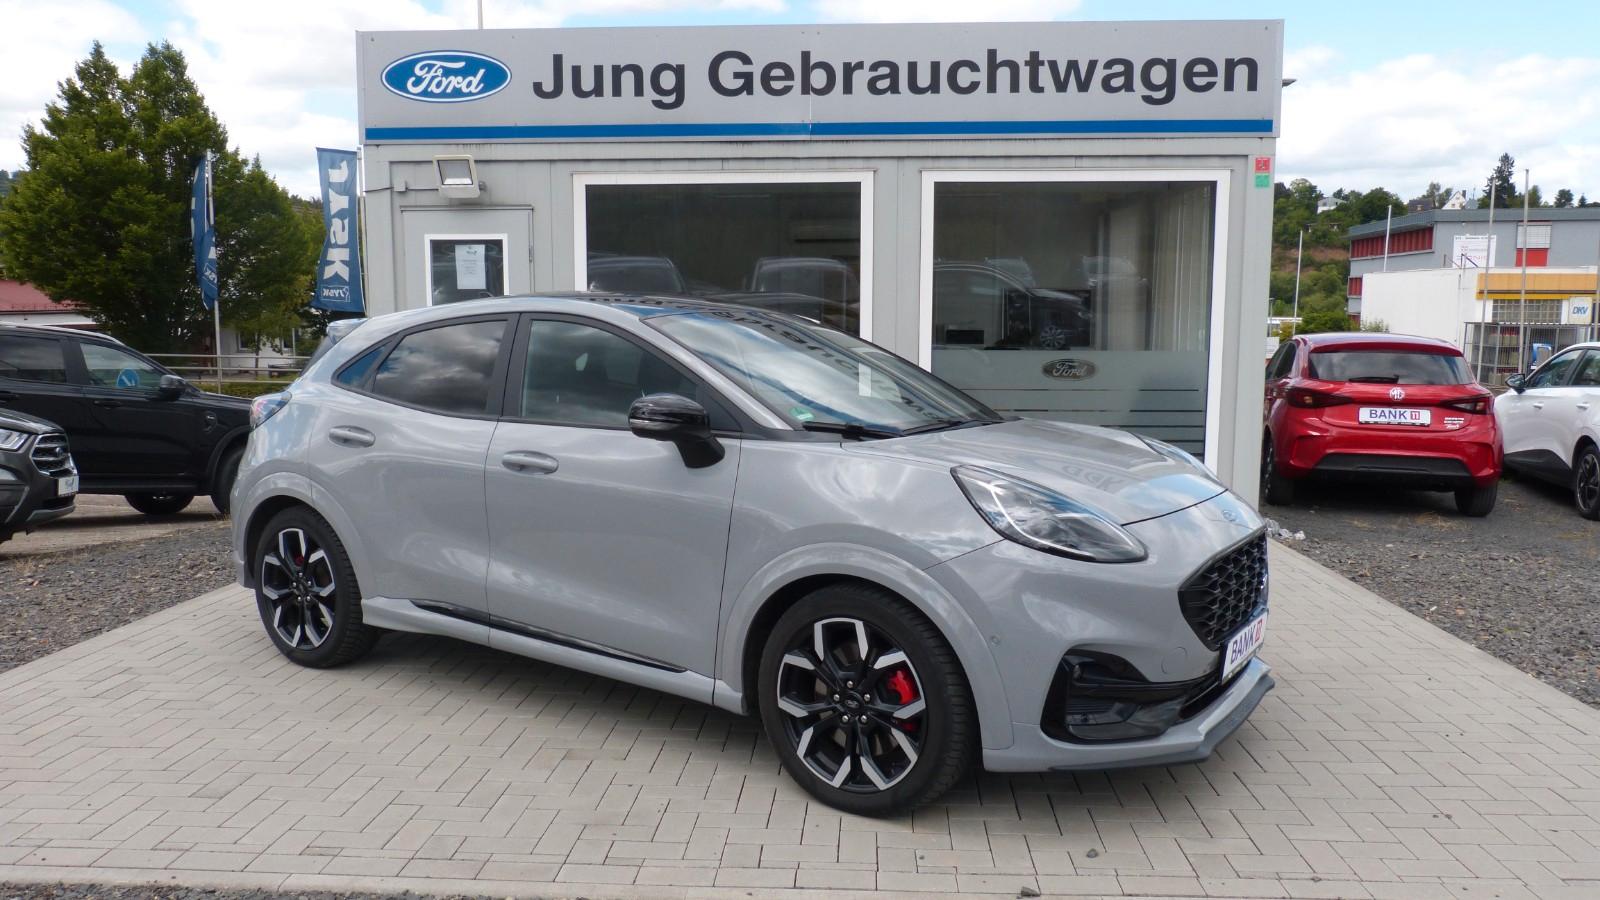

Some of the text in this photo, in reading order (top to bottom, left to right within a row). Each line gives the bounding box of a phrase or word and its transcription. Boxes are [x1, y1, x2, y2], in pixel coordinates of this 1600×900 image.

[407, 60, 485, 94] Ford
[532, 48, 1260, 110] Jung Gebrauchtwagen
[1572, 306, 1588, 314] DKV
[1053, 361, 1088, 377] Ford
[1369, 409, 1407, 420] BANK
[1231, 624, 1256, 664] BANK
